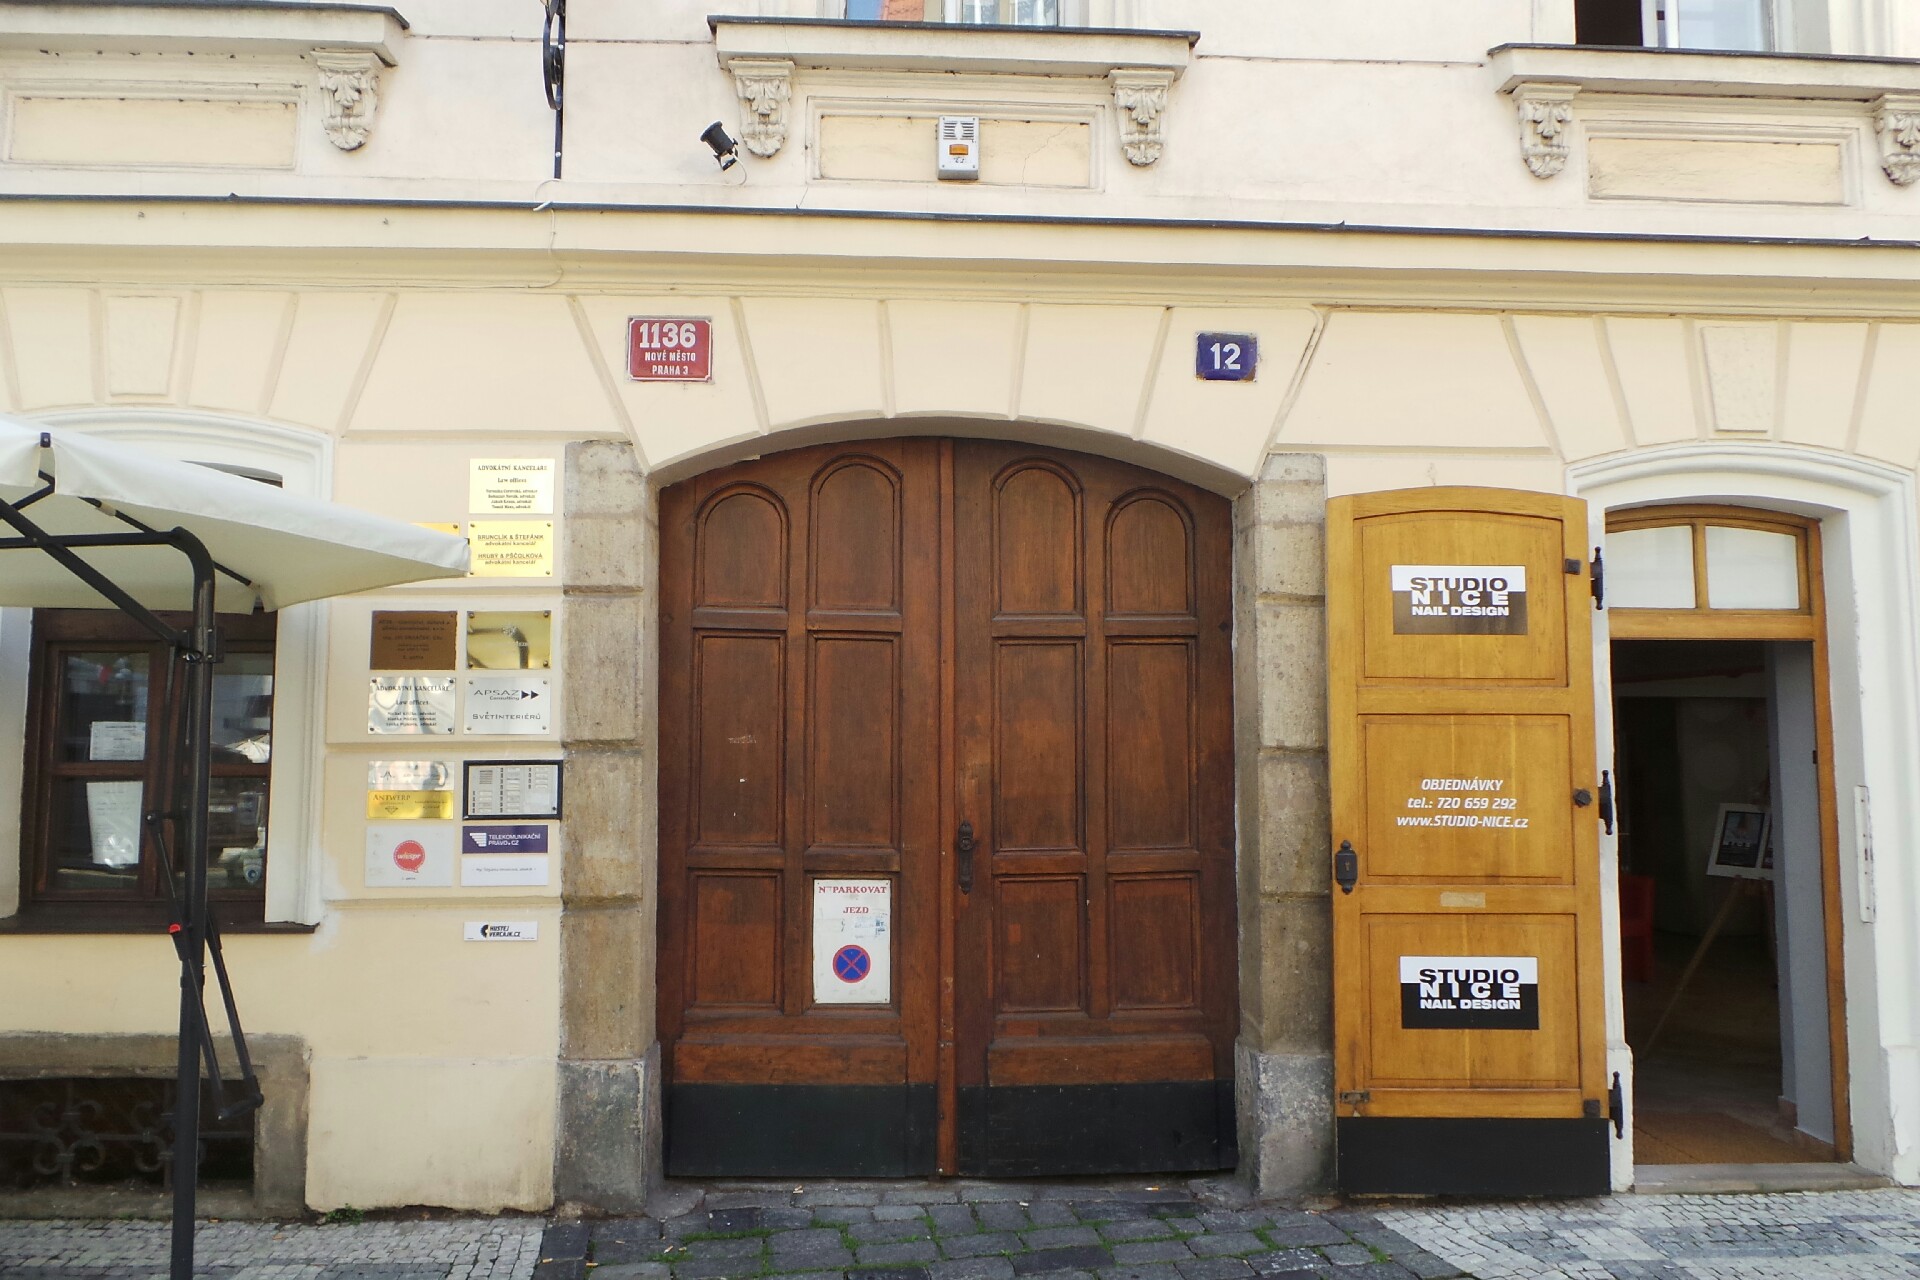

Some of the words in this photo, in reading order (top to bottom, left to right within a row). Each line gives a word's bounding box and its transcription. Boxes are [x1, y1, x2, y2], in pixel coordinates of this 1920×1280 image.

[639, 322, 696, 348] 1136
[644, 349, 667, 361] NOVÉ
[669, 349, 696, 362] MĚSTO
[1210, 342, 1241, 370] 12
[652, 365, 681, 375] PRAHA
[682, 365, 689, 376] 3
[1410, 576, 1508, 591] STUDIO
[1411, 590, 1509, 606] NICE
[1412, 606, 1448, 616] NAIL
[1450, 606, 1510, 617] DESIGN
[1421, 776, 1504, 791] OBJEDNÁVKY
[1407, 797, 1434, 809] tel.:
[1437, 797, 1461, 809] 720
[1464, 797, 1489, 809] 659
[1492, 798, 1518, 810] 292
[1396, 814, 1529, 828] www.STUDIO-NICE.cz
[1419, 968, 1520, 984] STUDIO
[1419, 982, 1521, 999] NICE
[1420, 999, 1457, 1009] NAIL
[1459, 999, 1521, 1010] DESIGN
